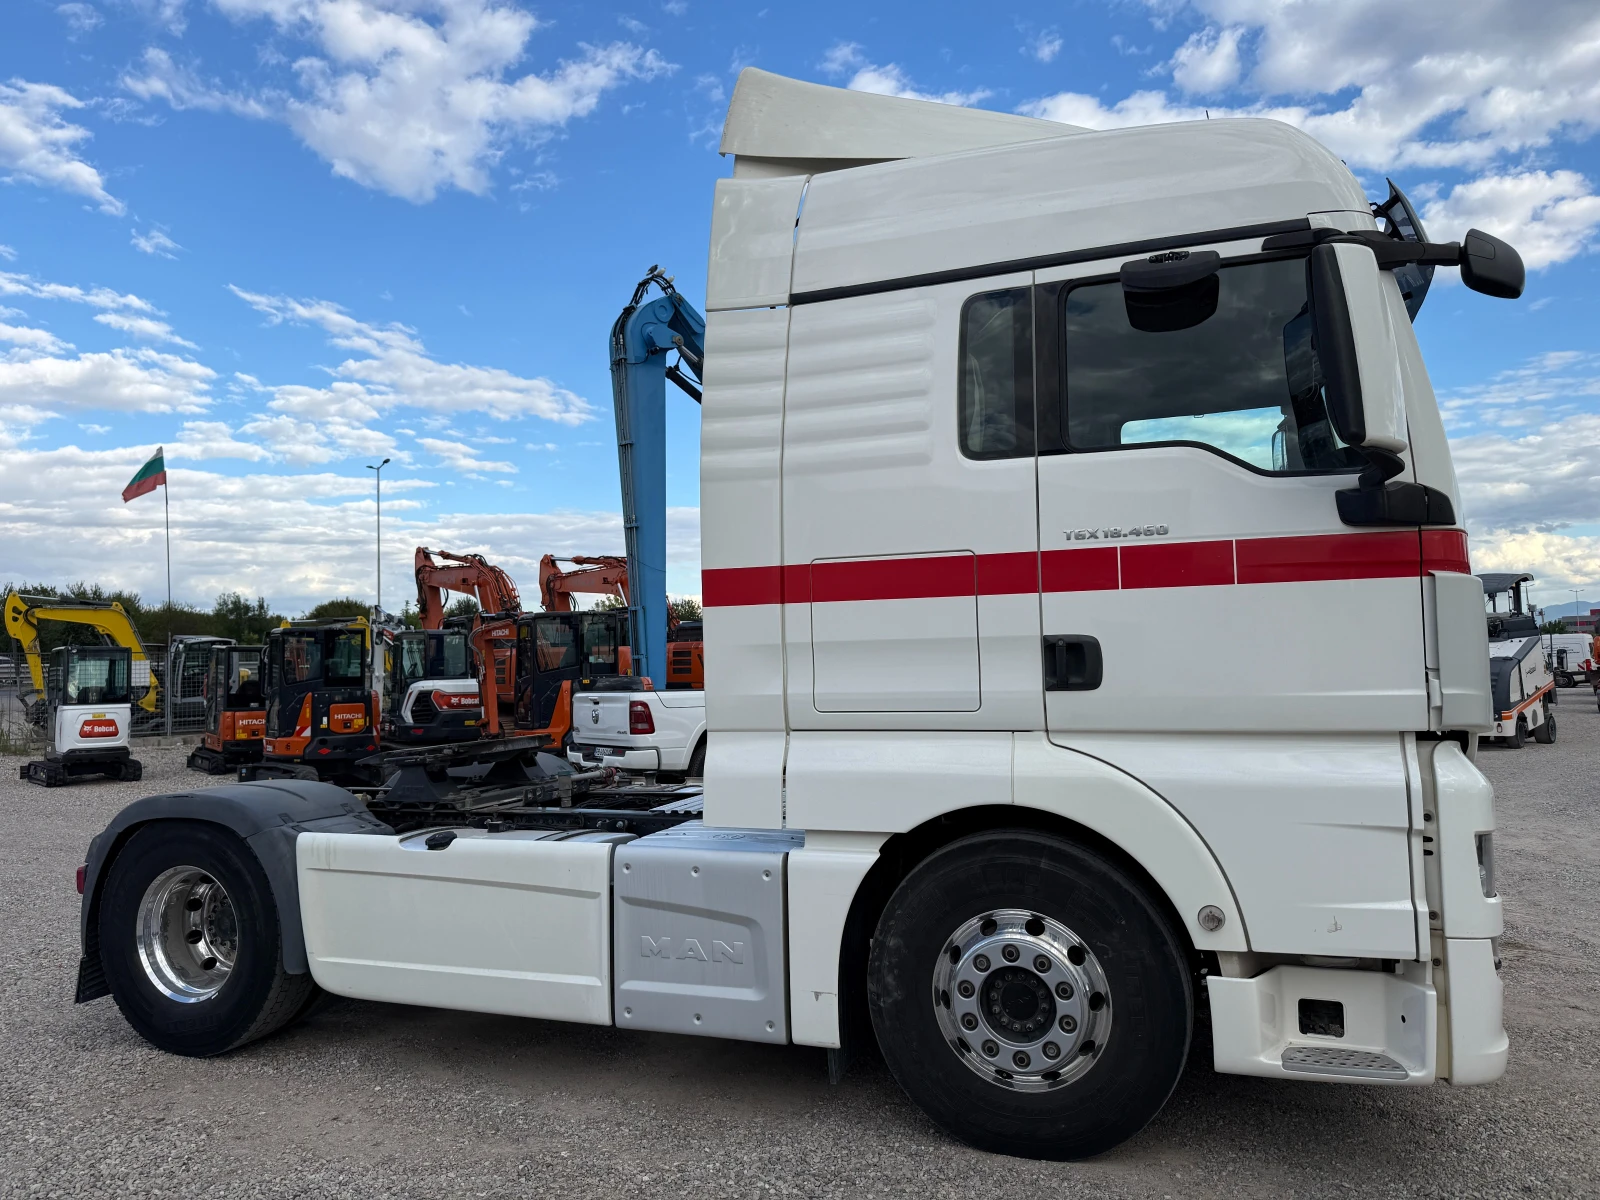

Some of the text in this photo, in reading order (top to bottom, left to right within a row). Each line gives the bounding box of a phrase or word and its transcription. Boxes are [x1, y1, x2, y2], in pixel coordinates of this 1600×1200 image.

[1063, 523, 1169, 541] TGX 18.460
[491, 629, 509, 637] HITACHI
[239, 718, 267, 726] HITACH
[641, 935, 744, 965] MAN
